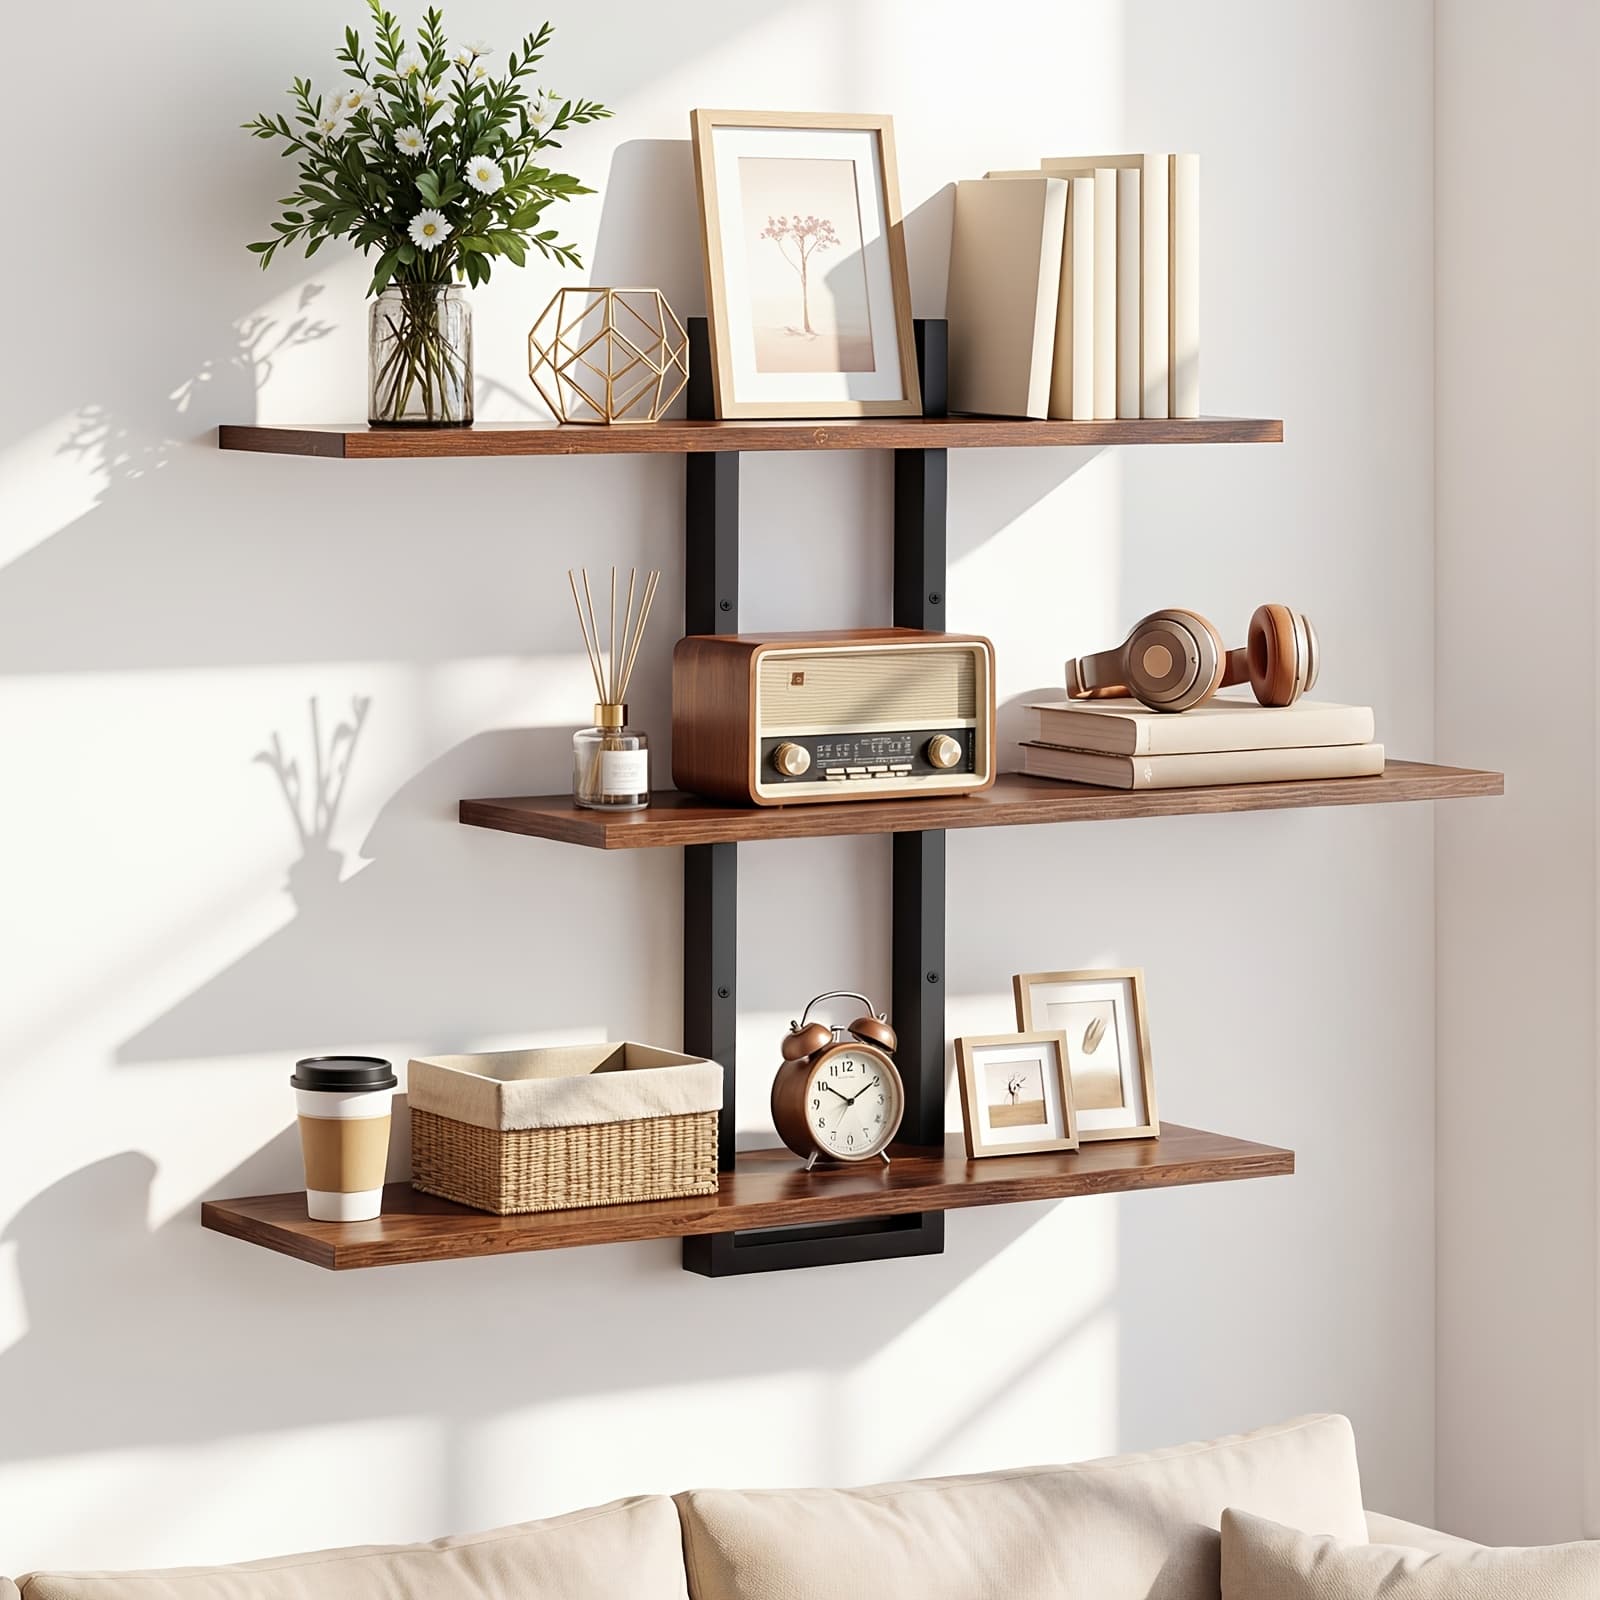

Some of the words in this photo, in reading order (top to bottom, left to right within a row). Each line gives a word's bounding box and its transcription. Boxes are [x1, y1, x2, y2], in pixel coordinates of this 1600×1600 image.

[830, 1065, 838, 1077] 11
[842, 1061, 853, 1073] 12
[861, 1063, 866, 1074] 1
[817, 1080, 829, 1092] 10
[813, 1099, 820, 1111] 9
[818, 1117, 826, 1129] 8
